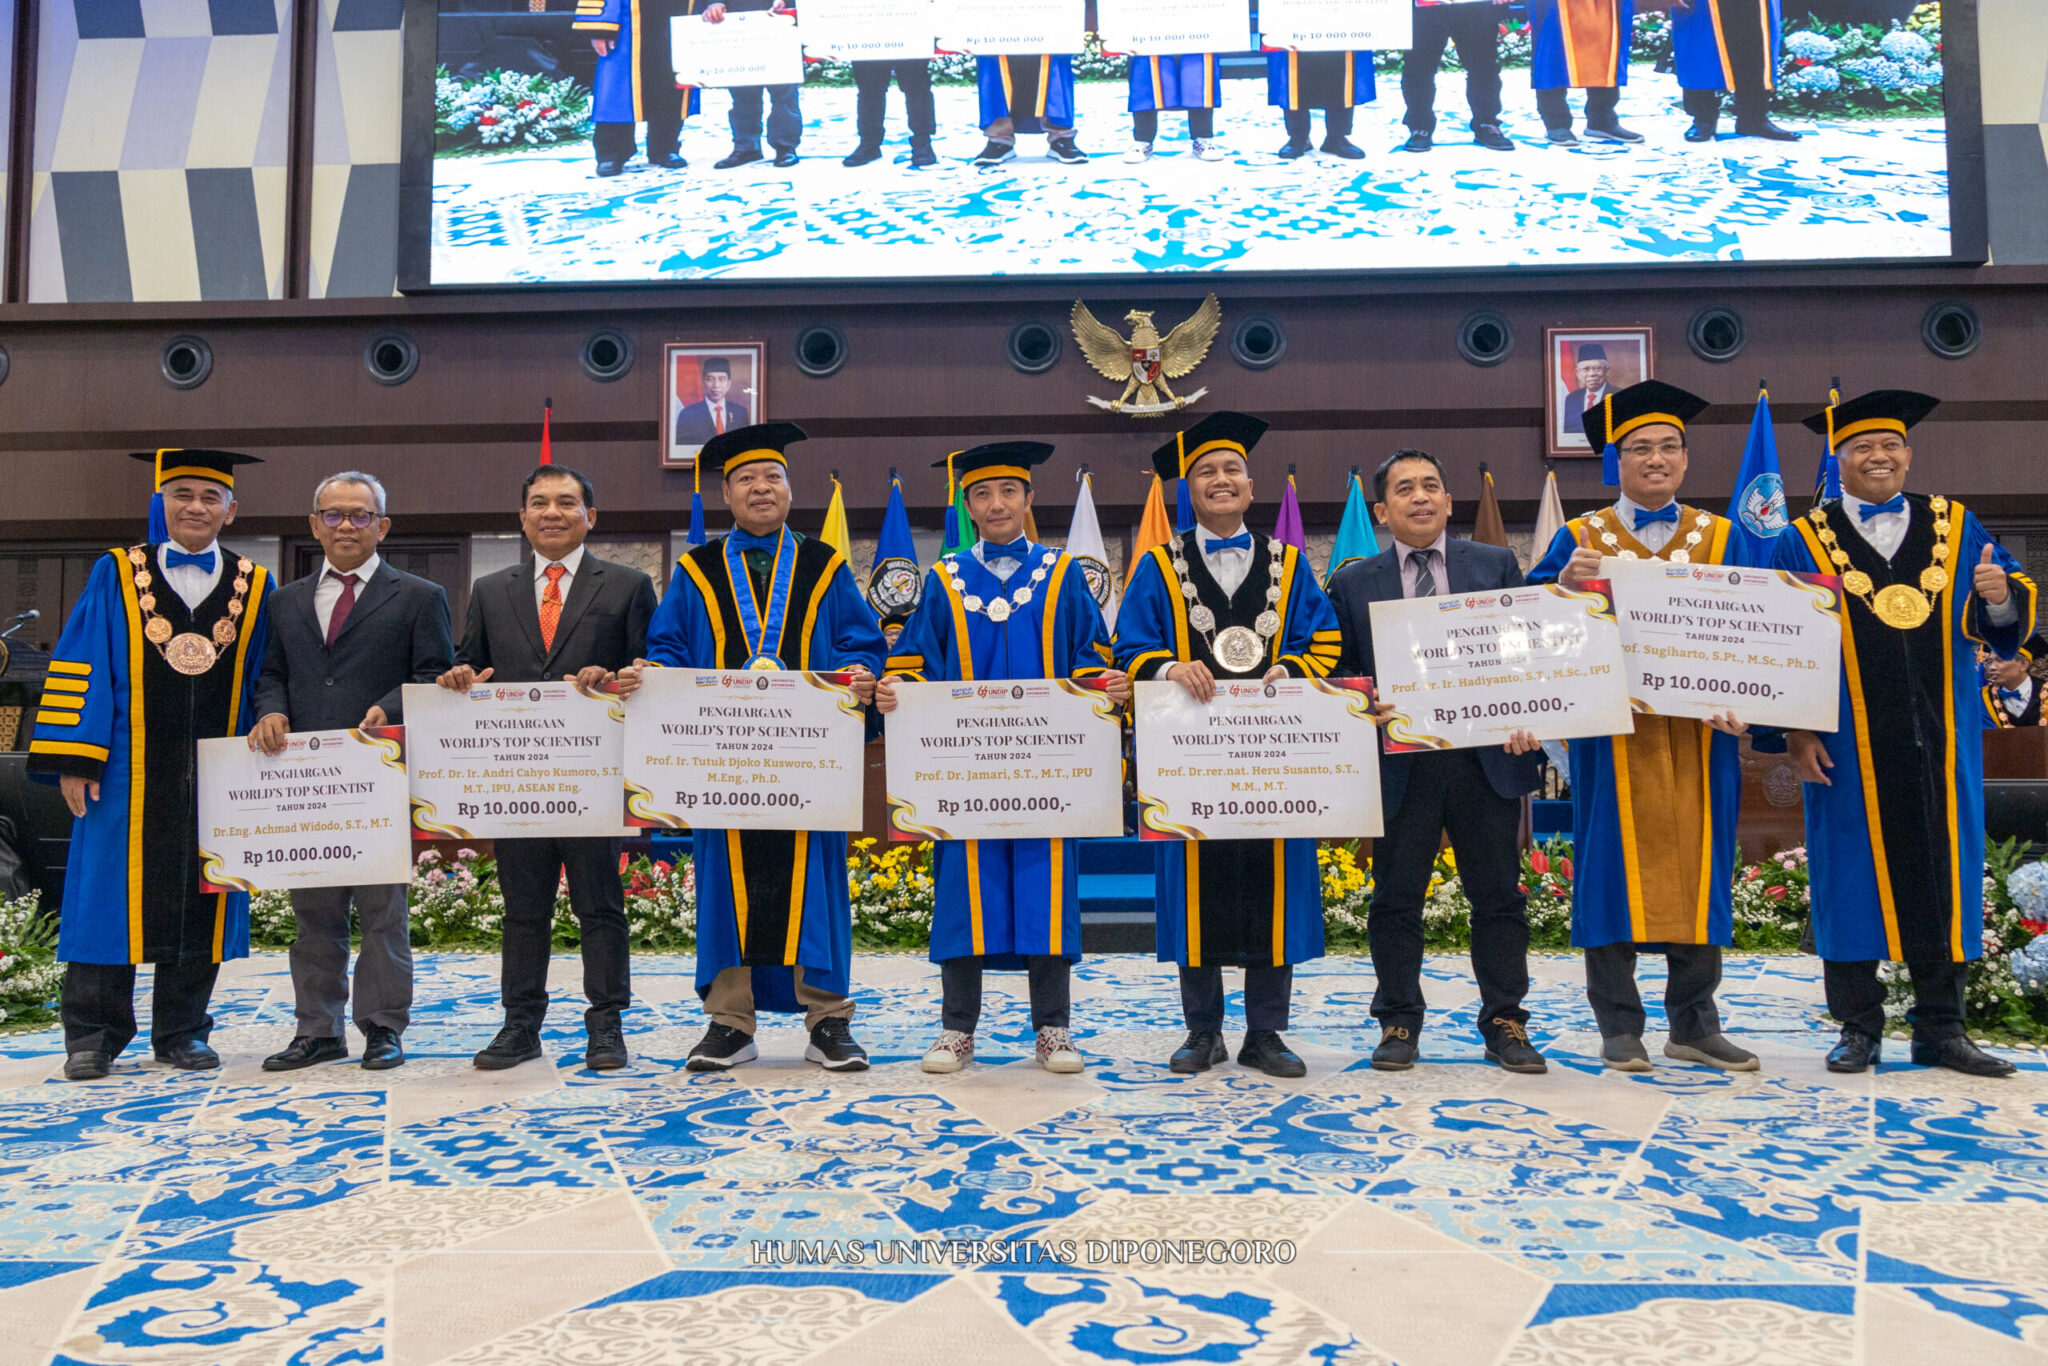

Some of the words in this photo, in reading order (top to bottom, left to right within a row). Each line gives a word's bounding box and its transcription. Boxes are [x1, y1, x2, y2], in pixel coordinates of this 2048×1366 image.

[1669, 597, 1765, 614] PENGHARGAAN
[1630, 611, 1693, 626] WORLD'S
[1697, 618, 1726, 628] TOP
[1729, 620, 1803, 635] SCIENTIST
[1686, 633, 1719, 642] TAHUN
[1469, 660, 1501, 668] TAHUN
[1622, 644, 1640, 653] of.
[1643, 645, 1709, 661] Sugiharto,
[1747, 655, 1783, 668] M.Sc.,
[1787, 658, 1820, 670] Ph.D.
[1392, 683, 1419, 693] Prof.
[1443, 679, 1456, 689] Ir.
[1459, 674, 1523, 687] Hadiyanto,
[1554, 668, 1587, 679] M.Sc.,
[1590, 665, 1610, 674] IPU
[1642, 673, 1664, 690] Rp
[1670, 676, 1784, 700] 10.000.000,-
[699, 707, 792, 718] PENGHARGAAN
[1434, 709, 1457, 724] Rp
[1461, 697, 1575, 719] 10.000.000,-
[475, 719, 565, 729] PENGHARGAAN
[957, 717, 1048, 728] PENGHARGAAN
[1209, 715, 1302, 726] PENGHARGAAN
[661, 724, 723, 736] WORLD'S
[727, 726, 755, 737] TOP
[758, 727, 828, 738] SCIENTIST
[440, 737, 500, 748] WORLD'S
[503, 737, 530, 747] TOP
[533, 736, 601, 747] SCIENTIST
[920, 737, 982, 748] WORLD'S
[985, 735, 1013, 746] TOP
[1016, 734, 1085, 746] SCIENTIST
[1172, 734, 1235, 745] WORLD'S
[1238, 734, 1266, 744] TOP
[1270, 732, 1341, 743] SCIENTIST
[645, 756, 673, 766] Prof.
[676, 757, 689, 765] Ir.
[692, 757, 726, 767] Tutuk
[729, 758, 760, 769] Djoko
[763, 759, 816, 769] Kusworo,
[819, 760, 842, 770] S.T.,
[261, 766, 342, 780] PENGHARGAAN
[419, 769, 445, 779] Prof.
[449, 769, 464, 778] Dr.
[467, 769, 479, 778] Ir.
[483, 768, 514, 778] Andri
[517, 768, 550, 779] Cahyo
[553, 768, 599, 778] Kumoro,
[915, 771, 944, 781] Prof.
[947, 771, 964, 780] Dr.
[968, 769, 1010, 781] Jamari,
[1013, 769, 1038, 780] S.T.,
[1041, 769, 1068, 779] M.T.,
[1072, 768, 1093, 777] IPU
[1158, 767, 1185, 777] Prof.
[1189, 767, 1249, 776] Dr.rer.nat.
[1252, 766, 1280, 775] Heru
[1283, 765, 1332, 775] Susanto,
[1336, 765, 1359, 775] S.T.,
[708, 773, 749, 785] M.Eng.,
[752, 774, 781, 783] Ph.D.
[229, 788, 283, 800] WORLD'S
[285, 786, 309, 798] TOP
[312, 782, 375, 796] SCIENTIST
[464, 785, 489, 794] M.T.,
[492, 784, 514, 794] IPU,
[518, 783, 555, 792] ASEAN
[558, 783, 581, 794] Eng.
[1231, 782, 1261, 792] M.M.,
[1264, 782, 1287, 791] M.T.
[276, 803, 305, 811] TAHUN
[307, 802, 326, 810] 2024
[676, 792, 697, 808] Rp
[702, 792, 811, 809] 10.000.000,-
[938, 800, 959, 816] Rp
[964, 797, 1071, 813] 10.000.000,-
[458, 803, 479, 818] Rp
[484, 801, 588, 816] 10.000.000,-
[1191, 802, 1214, 818] Rp
[1218, 800, 1329, 816] 10.000.000,-
[213, 827, 251, 838] Dr.Eng.
[254, 823, 297, 835] Achmad
[300, 820, 343, 832] Widodo,
[345, 820, 367, 829] S.T.,
[370, 818, 392, 828] M.T.
[243, 851, 263, 866] Rp
[266, 845, 362, 863] 10.000.000,-
